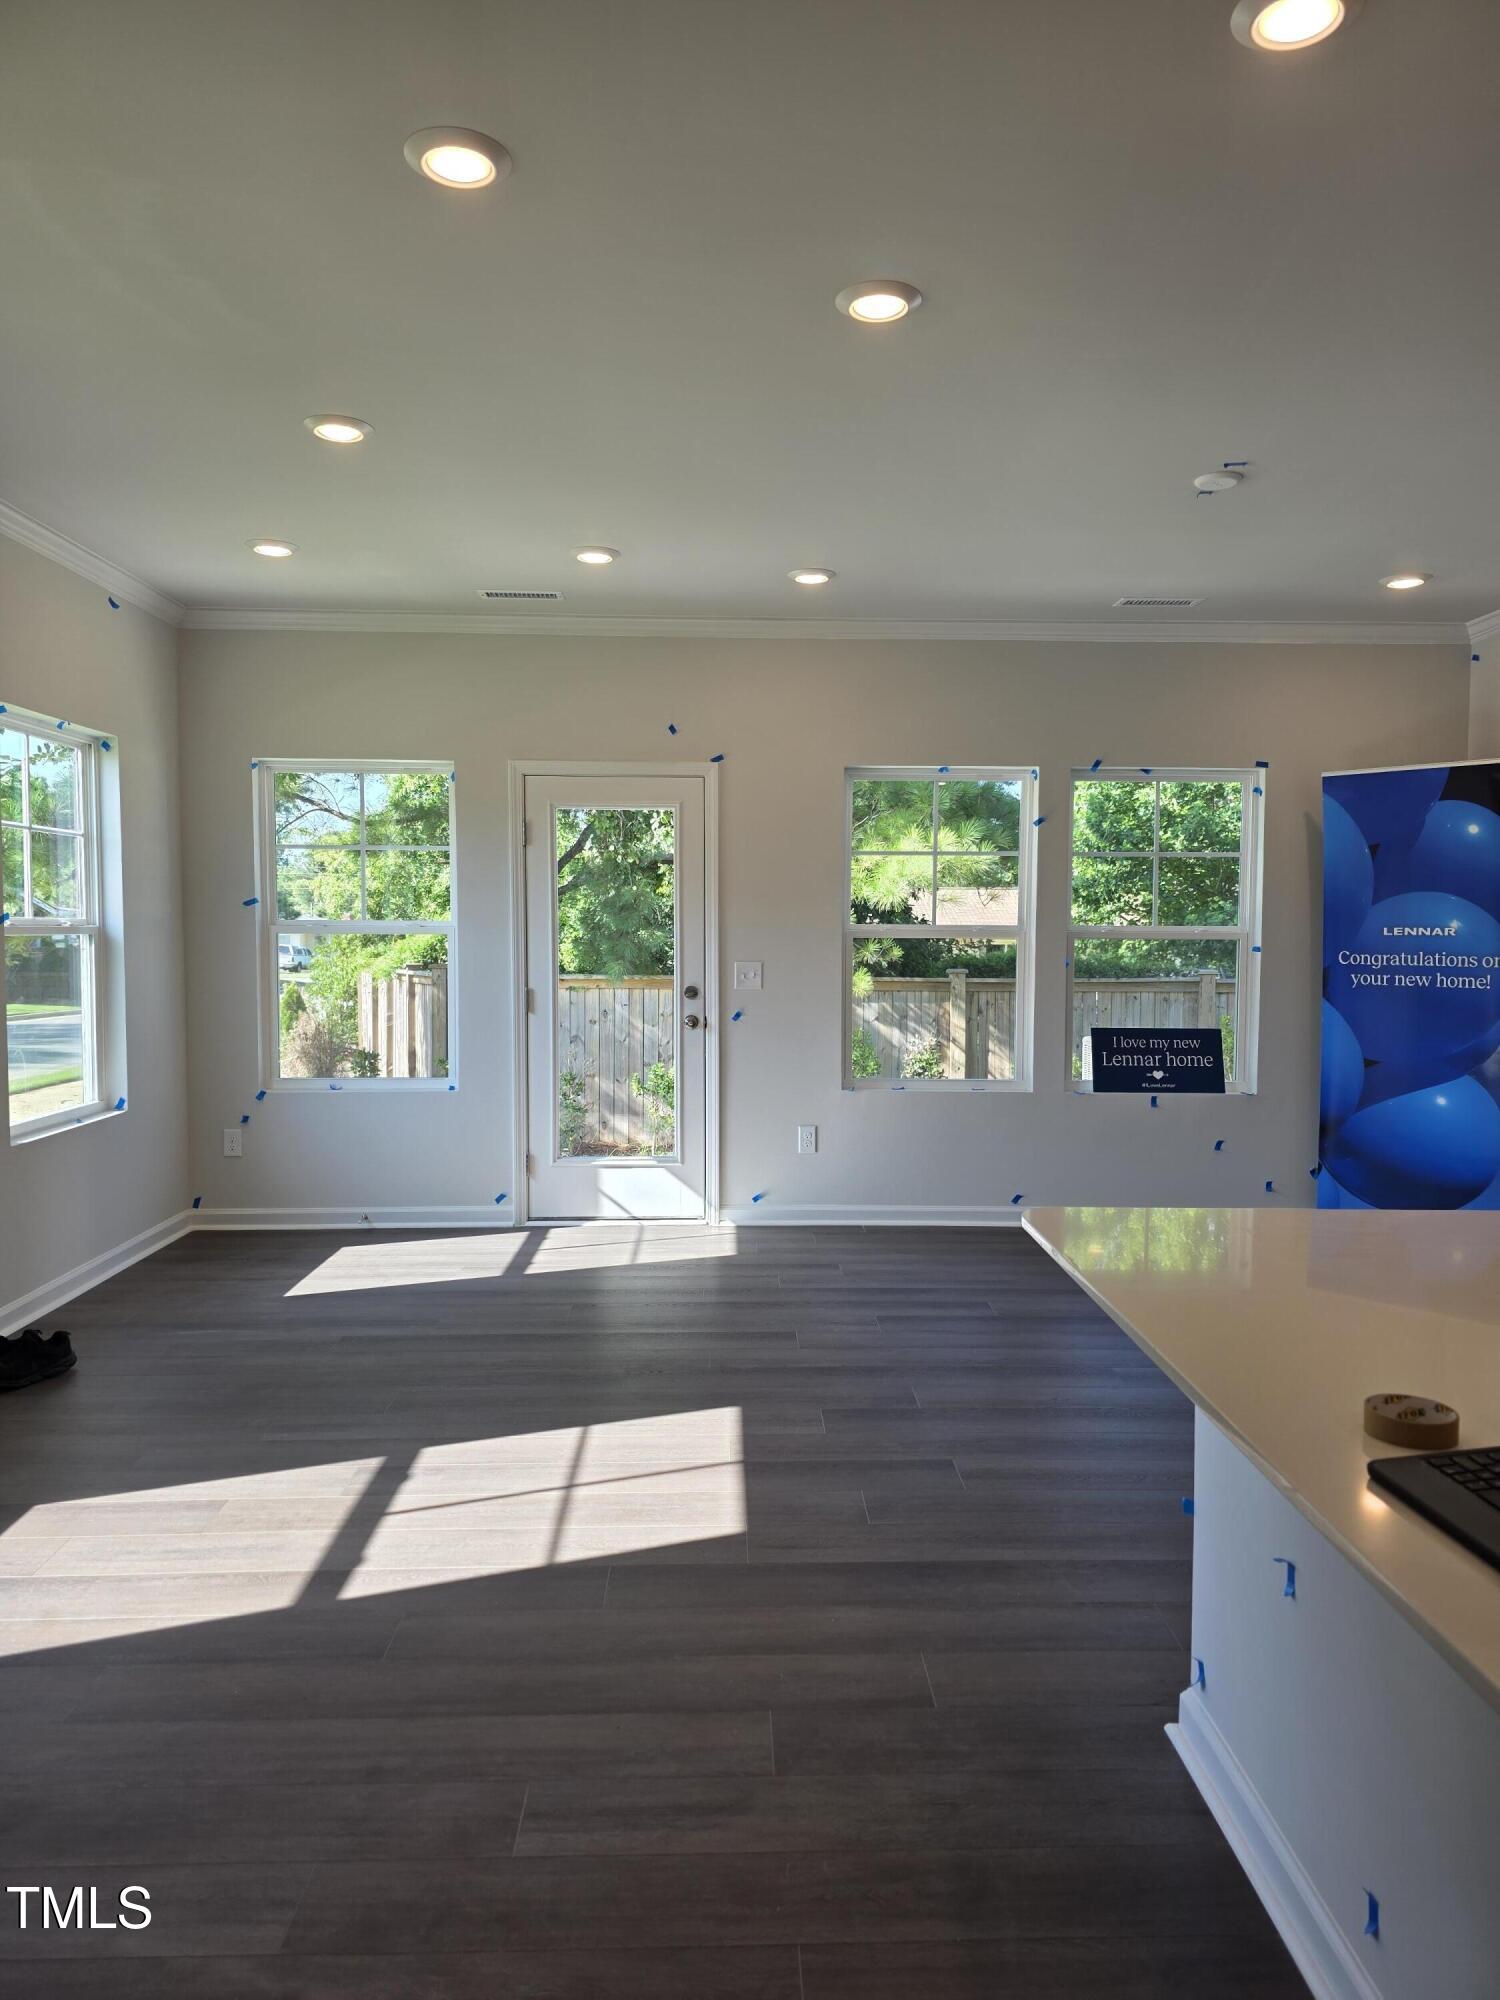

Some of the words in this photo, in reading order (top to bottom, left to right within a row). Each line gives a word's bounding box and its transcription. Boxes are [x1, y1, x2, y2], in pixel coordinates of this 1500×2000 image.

[1383, 927, 1456, 936] LENNAR
[1338, 951, 1478, 969] Congratulations
[1351, 974, 1390, 988] your
[1394, 974, 1432, 986] new
[1436, 973, 1491, 989] home!
[1113, 1036, 1117, 1048] I
[1120, 1036, 1146, 1048] love
[1150, 1039, 1170, 1051] my
[1173, 1039, 1201, 1049] new
[1102, 1052, 1162, 1066] Lennar
[1165, 1052, 1214, 1067] home
